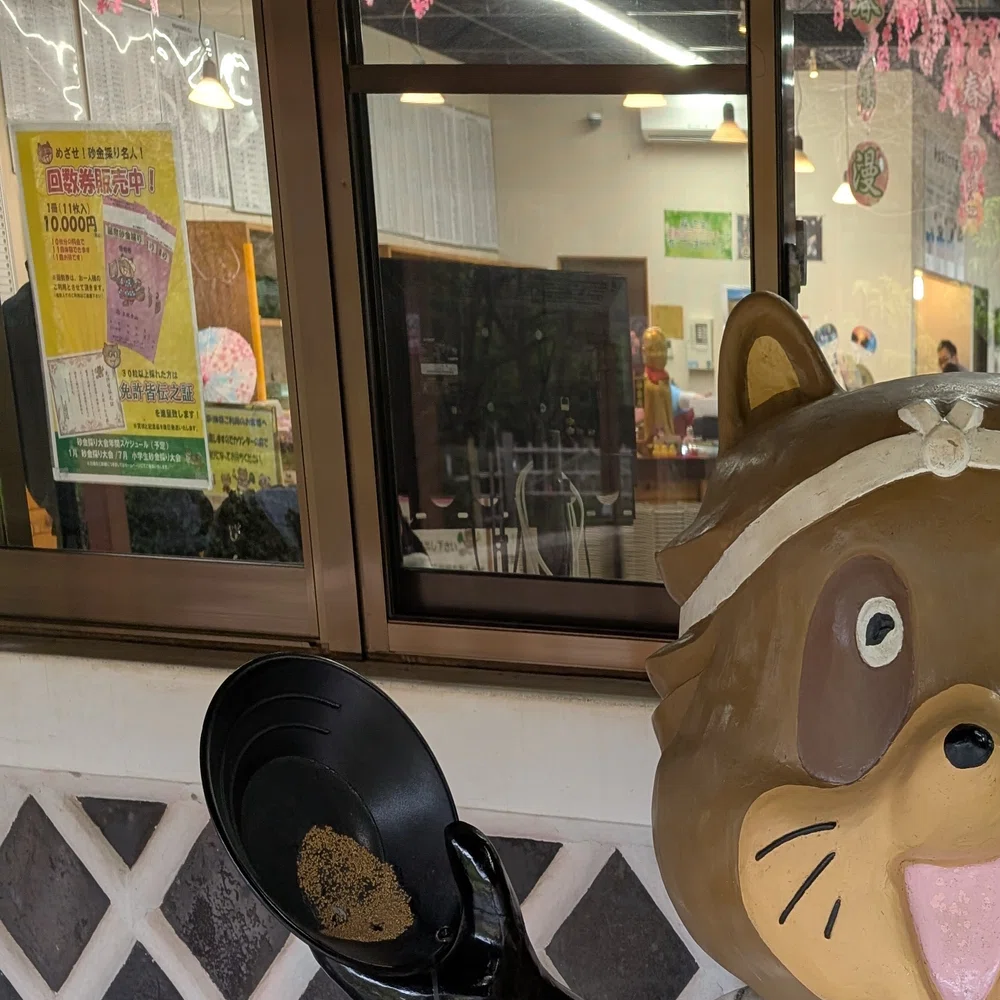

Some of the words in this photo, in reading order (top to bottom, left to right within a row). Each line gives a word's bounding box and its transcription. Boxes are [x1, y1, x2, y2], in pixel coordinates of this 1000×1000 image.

[46, 165, 155, 196] 回数券販売中！
[852, 146, 884, 199] 漫
[120, 381, 196, 403] 免許皆伝之証
